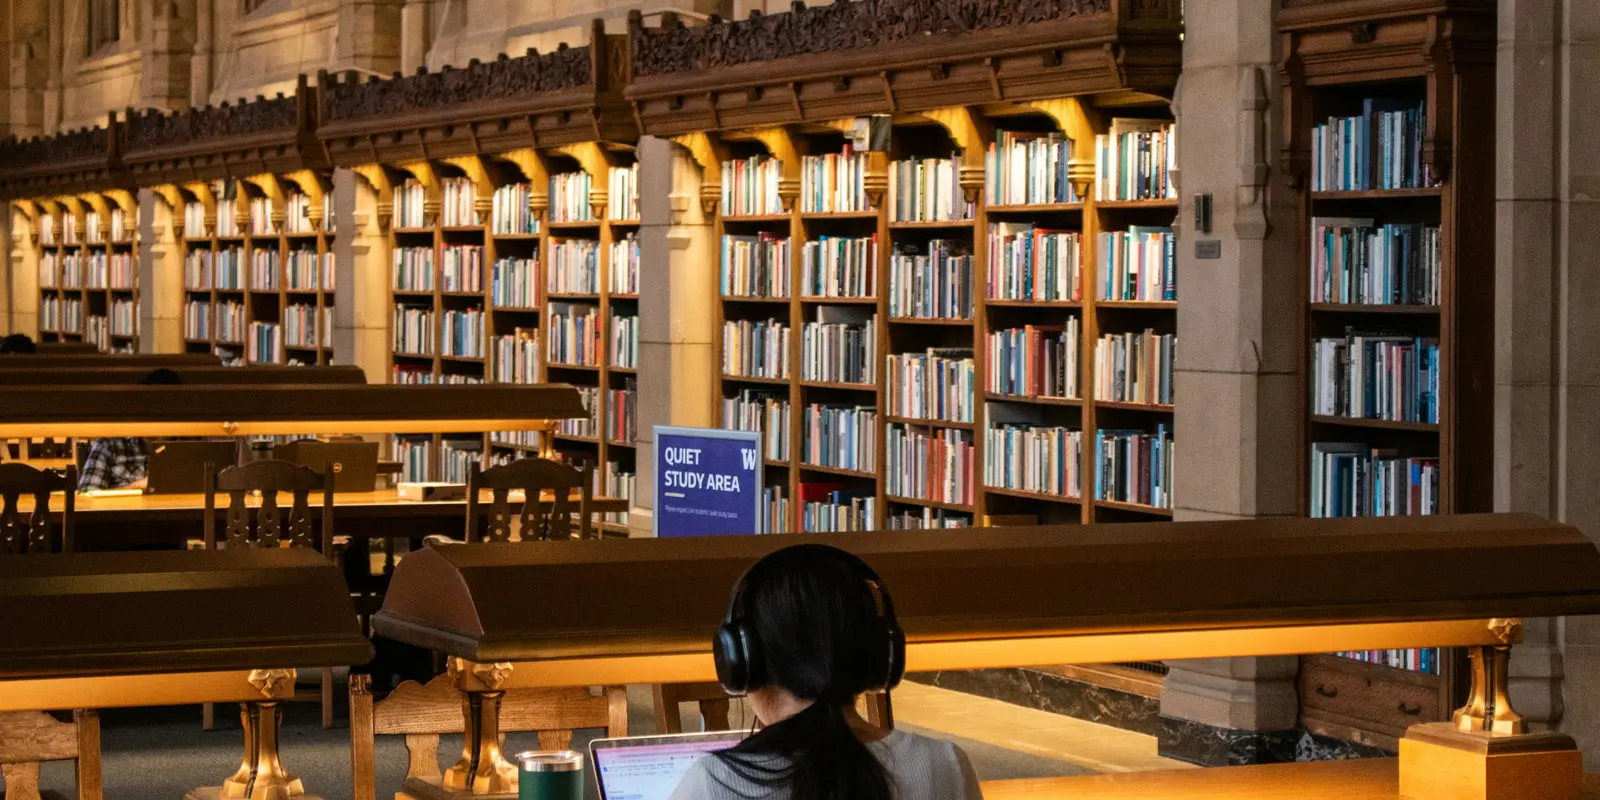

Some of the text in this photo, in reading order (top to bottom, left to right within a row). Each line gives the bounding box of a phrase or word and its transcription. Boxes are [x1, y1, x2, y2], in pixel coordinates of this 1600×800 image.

[665, 446, 702, 466] QUIET
[741, 448, 756, 471] W
[665, 470, 740, 493] STUDY AREA
